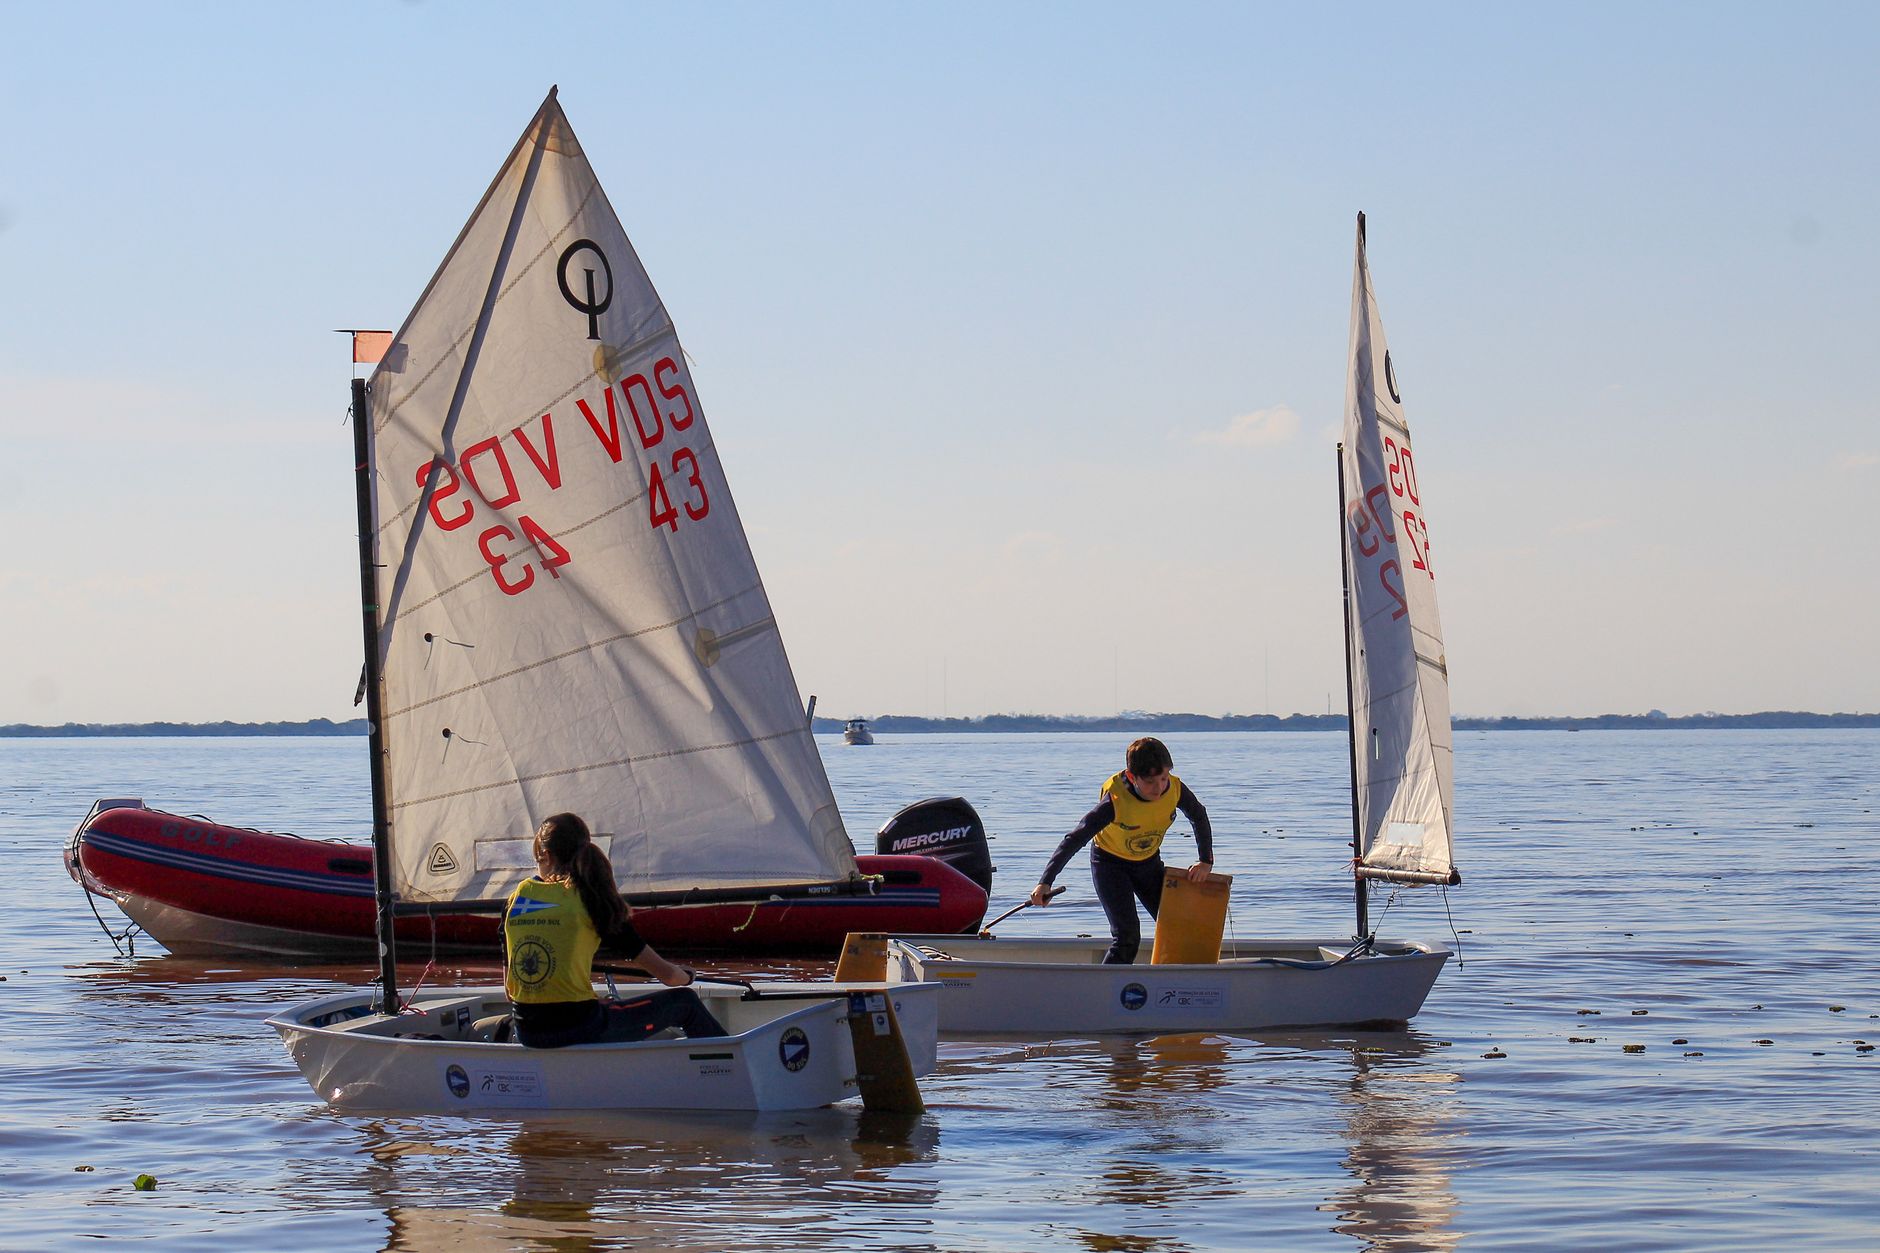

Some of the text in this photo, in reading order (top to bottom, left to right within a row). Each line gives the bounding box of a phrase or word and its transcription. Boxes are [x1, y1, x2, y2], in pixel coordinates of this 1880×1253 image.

[575, 356, 694, 463] VDS
[649, 447, 710, 533] 43
[892, 825, 971, 851] MERCURY
